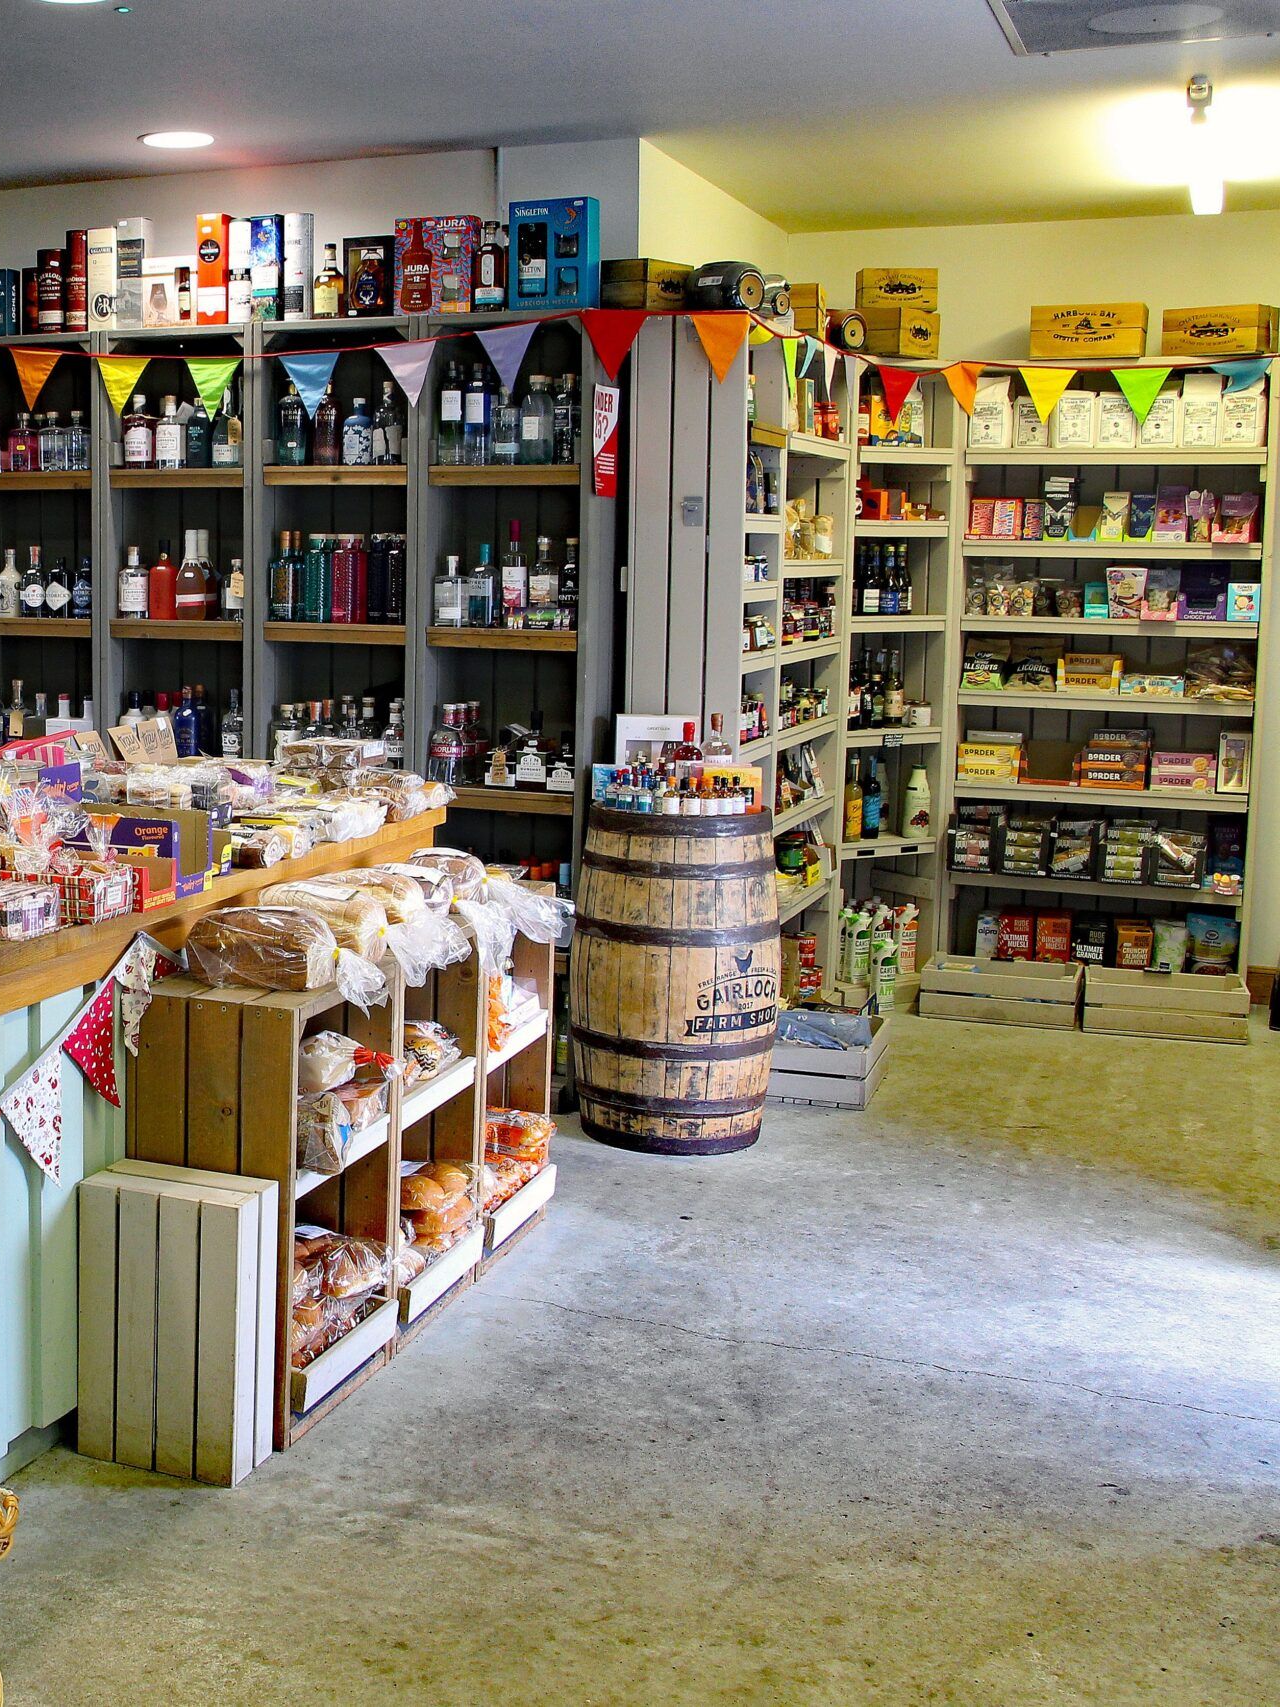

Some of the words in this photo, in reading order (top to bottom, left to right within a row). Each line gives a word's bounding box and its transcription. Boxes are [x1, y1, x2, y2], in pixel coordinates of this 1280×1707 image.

[514, 207, 548, 217] SINGLETON
[437, 219, 466, 228] JURA
[1054, 310, 1097, 319] HARB
[1053, 334, 1079, 342] OYSTER
[1083, 333, 1116, 342] COMPANY
[1017, 664, 1050, 673] LICORICE
[1065, 677, 1097, 685] BORDER
[1094, 733, 1126, 741] BORDER
[964, 749, 995, 757] BORDER
[1088, 753, 1121, 762] BORDER
[1158, 756, 1190, 764] BORDER
[964, 768, 995, 776] BORDER
[1088, 772, 1121, 781] BORDER
[1158, 777, 1190, 785] BORDER
[134, 827, 169, 837] Orange
[978, 928, 998, 936] alpro
[1003, 934, 1028, 942] ULTIMATE
[1008, 940, 1029, 948] MUESLI
[1045, 942, 1067, 950] MUESLI
[1076, 944, 1104, 954] ULTIMATE
[1076, 951, 1103, 960] GRANOLA
[698, 979, 715, 989] FREE
[716, 971, 737, 985] RANGE
[697, 978, 777, 1011] GAIRLOCH
[738, 1002, 754, 1010] 2017
[696, 1014, 742, 1030] FARM
[750, 1010, 777, 1025] SHOP
